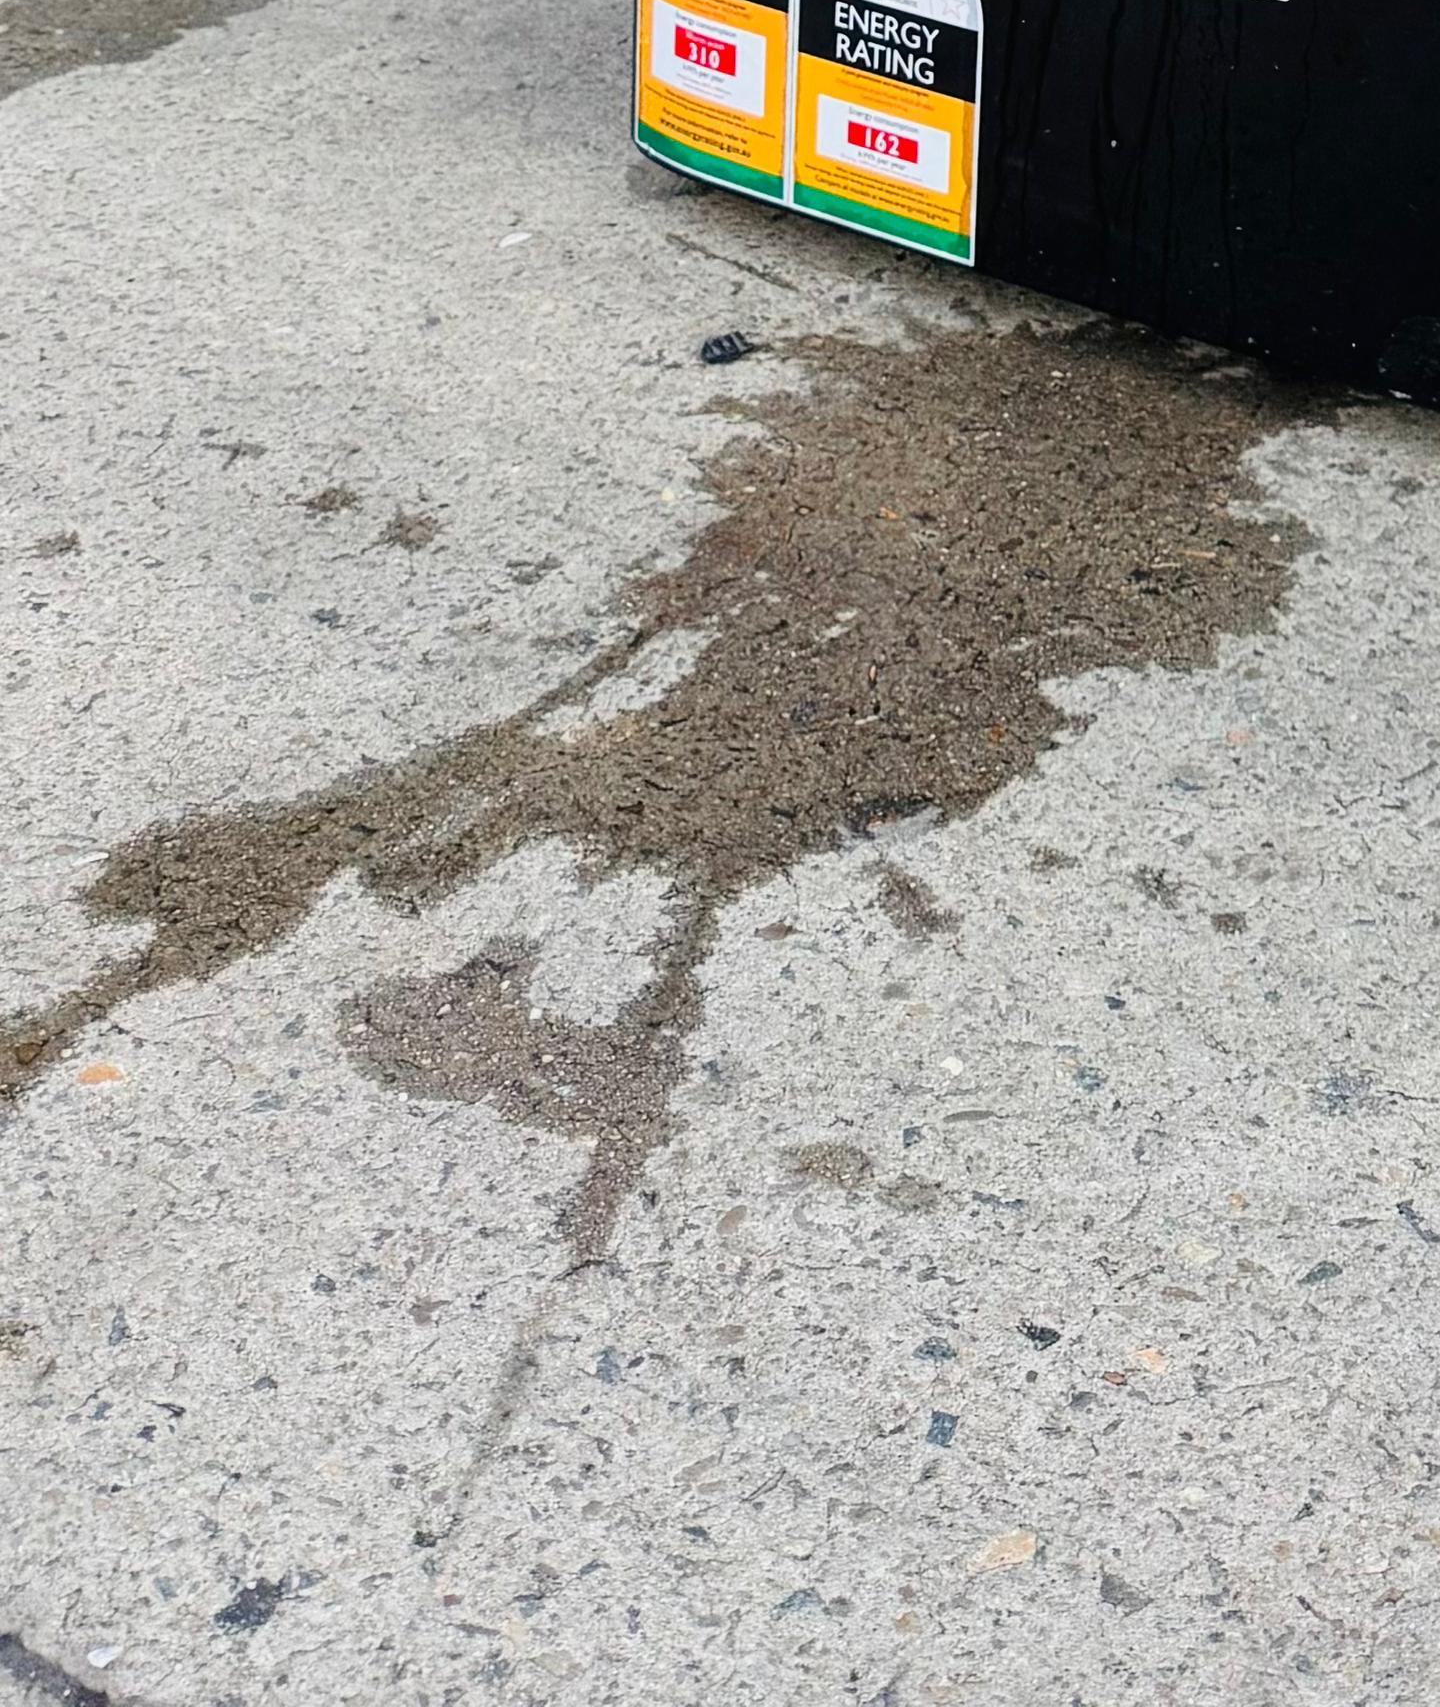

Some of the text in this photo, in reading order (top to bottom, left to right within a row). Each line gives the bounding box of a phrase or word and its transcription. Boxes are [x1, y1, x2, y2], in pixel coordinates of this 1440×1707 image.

[834, 0, 940, 54] ENERGY
[688, 42, 721, 69] 310
[835, 32, 935, 85] RATING
[864, 128, 900, 157] 162
